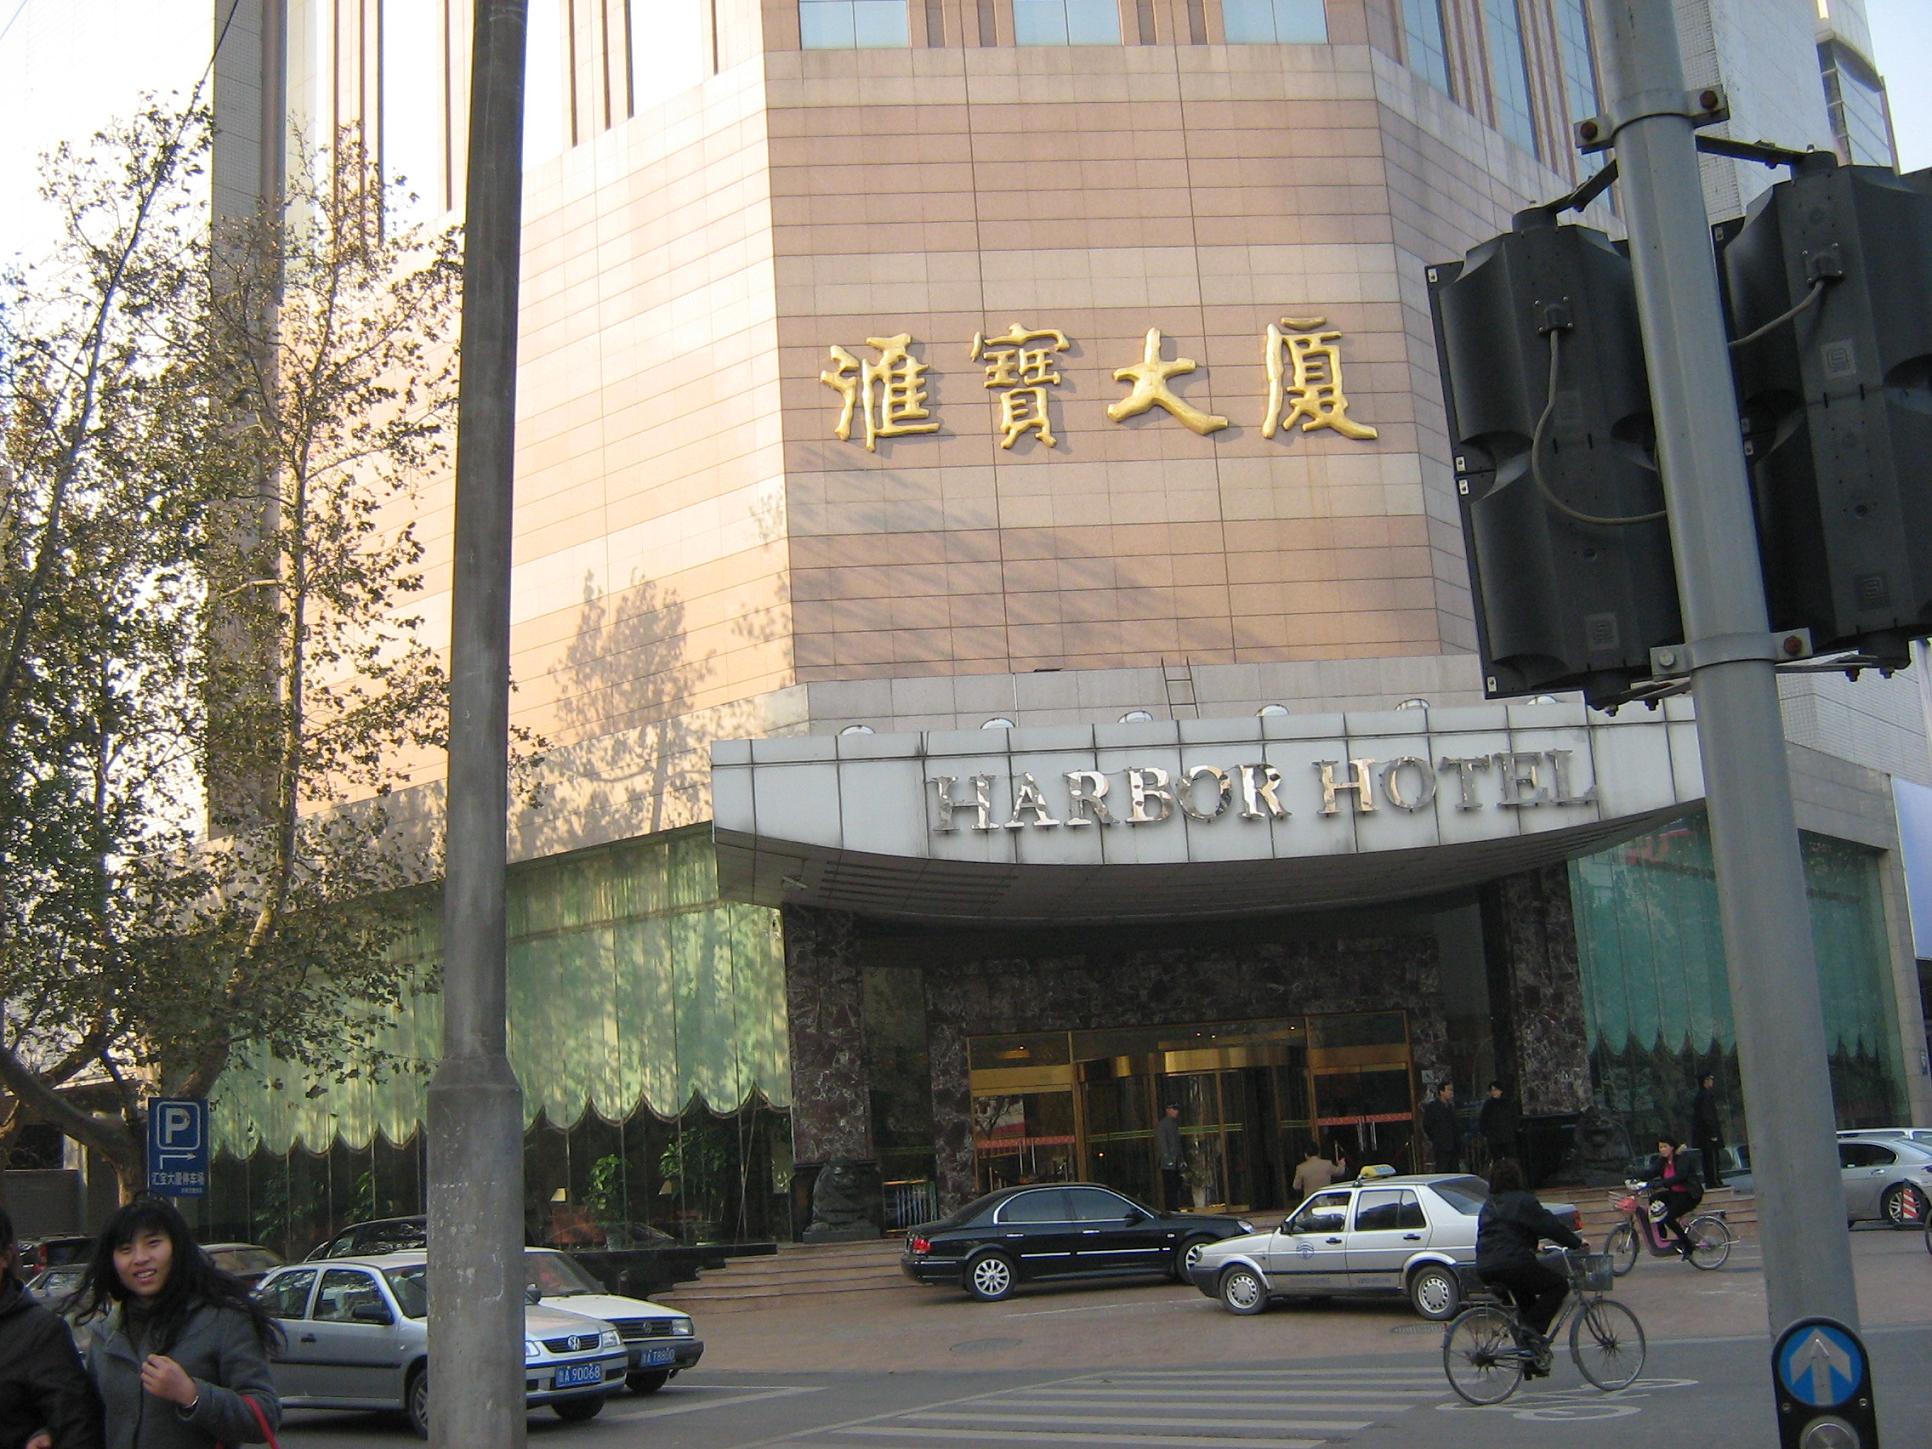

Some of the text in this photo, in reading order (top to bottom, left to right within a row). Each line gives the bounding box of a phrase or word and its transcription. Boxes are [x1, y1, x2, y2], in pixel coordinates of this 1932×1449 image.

[930, 748, 1601, 831] HARBOR HOTEL
[165, 1107, 191, 1144] P
